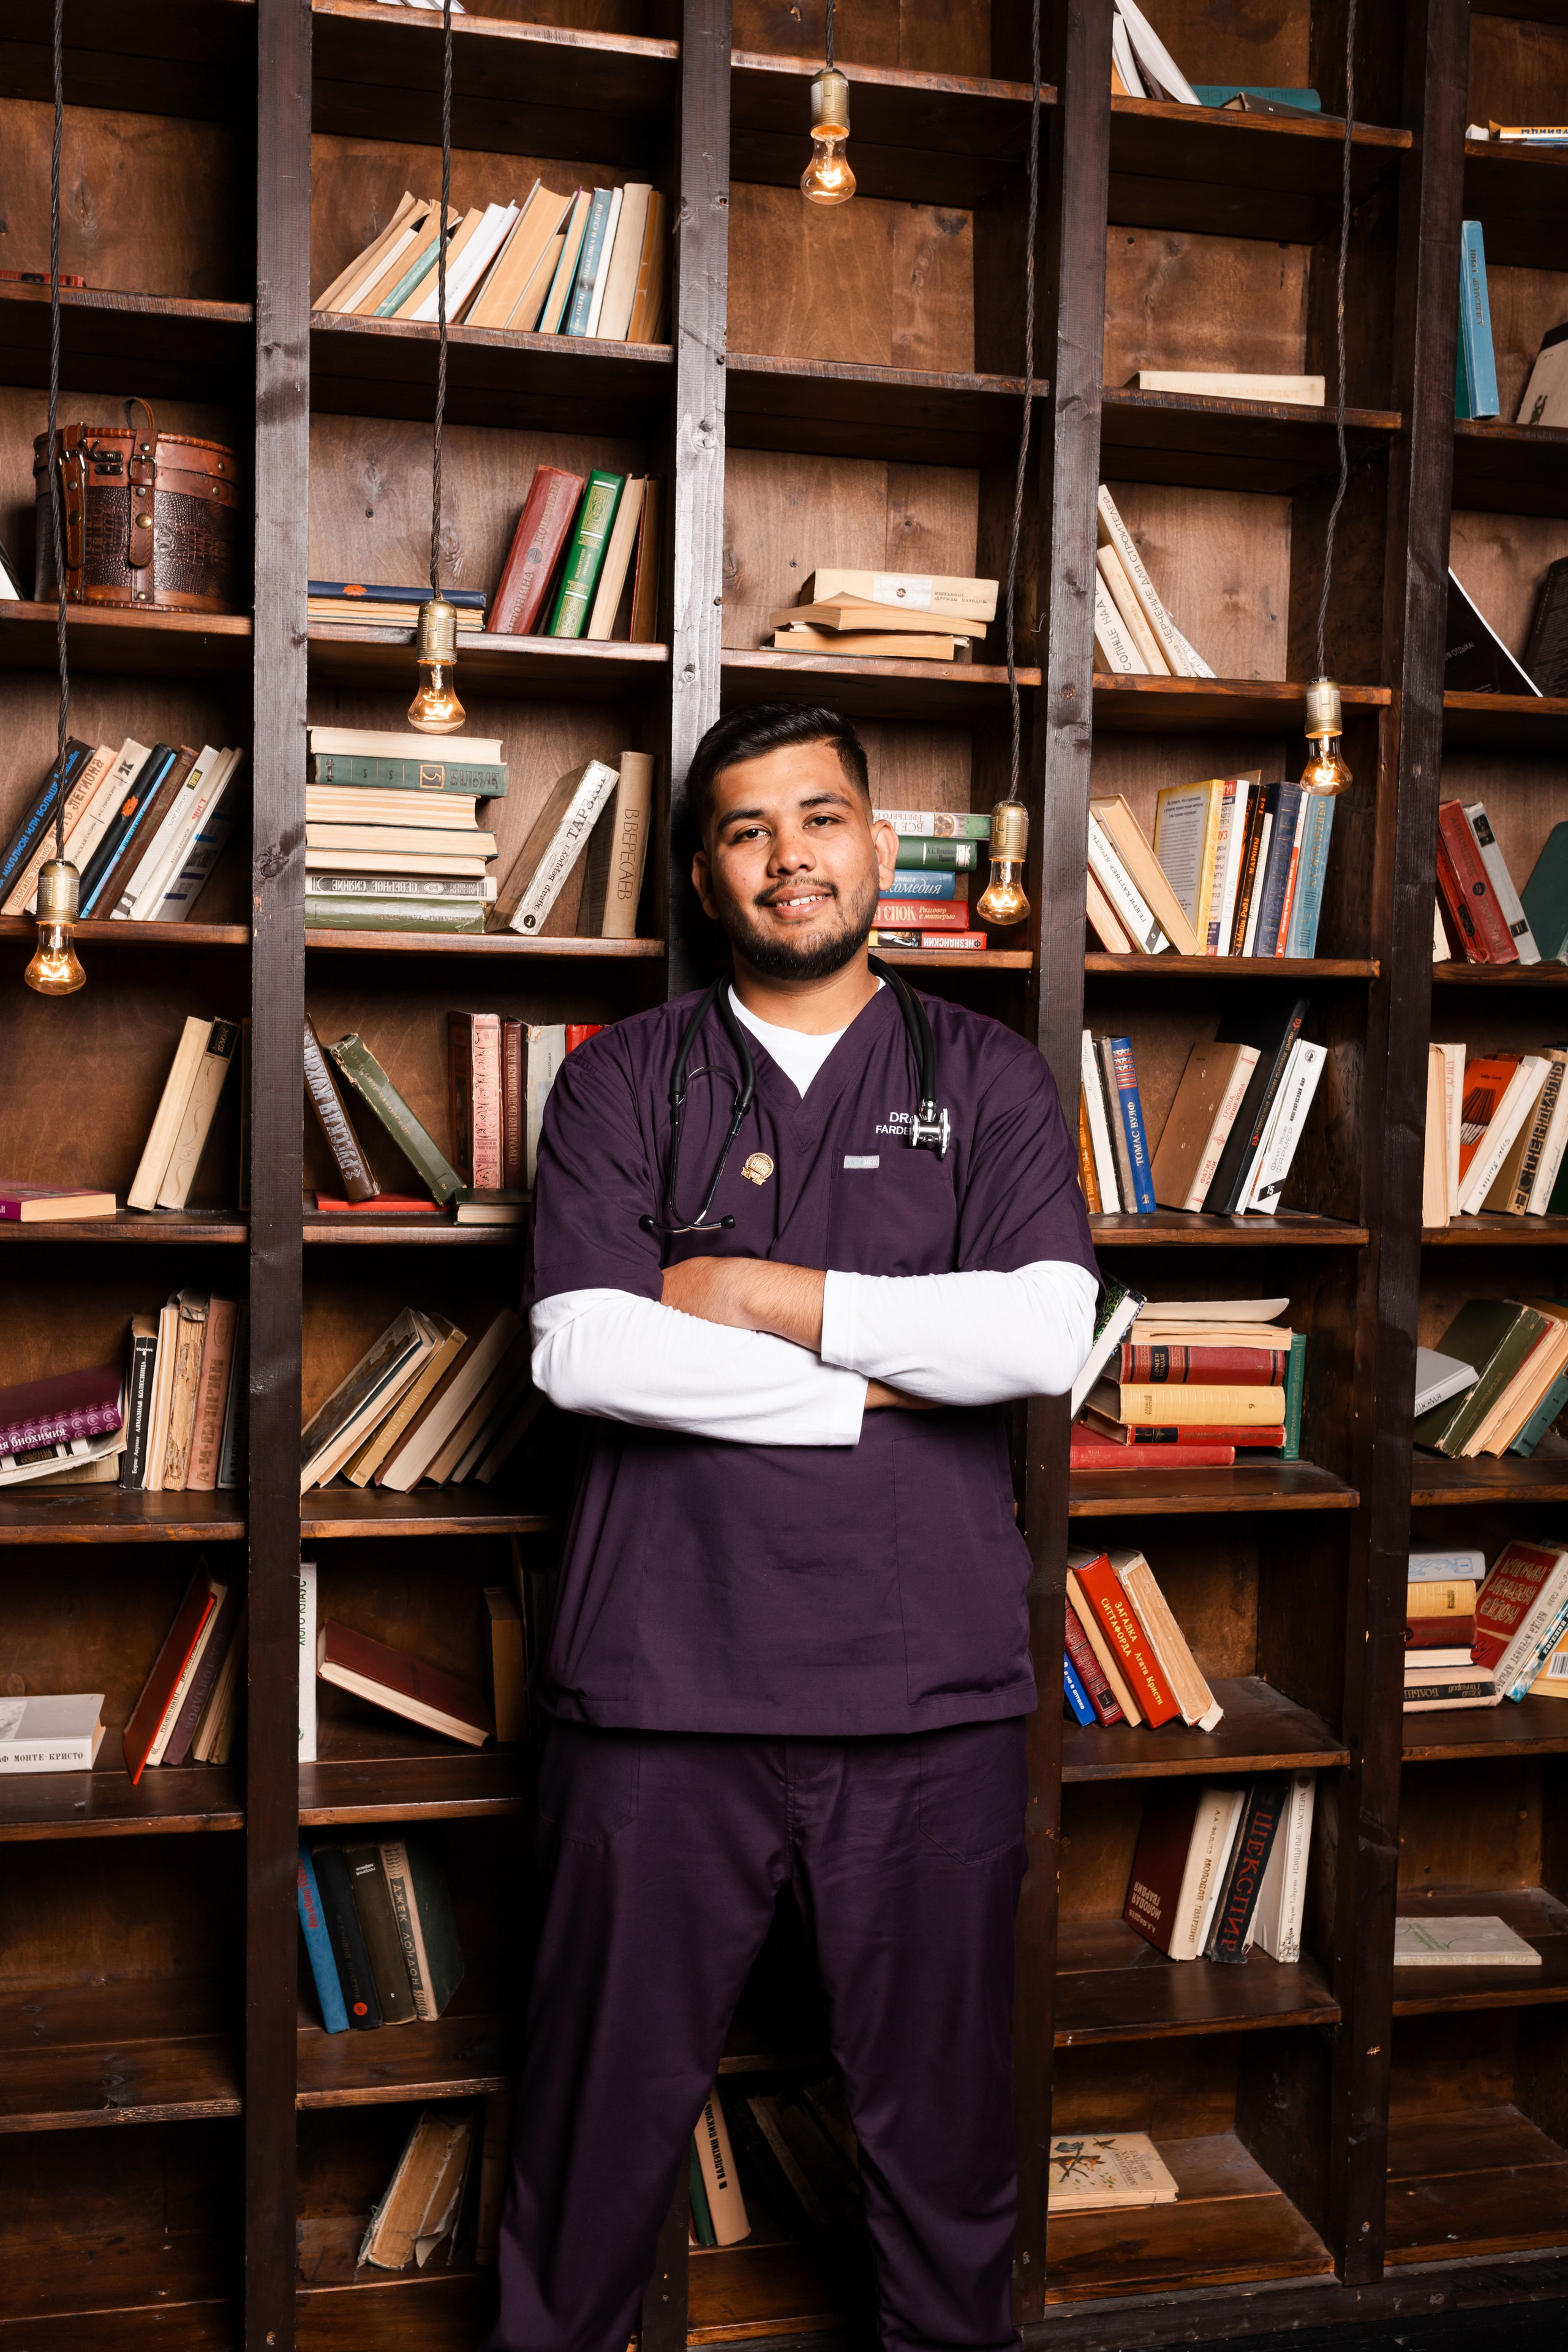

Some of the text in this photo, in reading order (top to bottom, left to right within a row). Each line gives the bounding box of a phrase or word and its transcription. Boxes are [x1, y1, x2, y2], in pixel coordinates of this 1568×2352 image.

[582, 239, 595, 279] АНЖЕЛИКА
[592, 203, 603, 230] СУЛТАН
[1474, 277, 1484, 326] АЛЕКСАНДР
[505, 477, 563, 635] АНТОНИНА КОПТЯЕВА
[572, 548, 588, 578] ВАЛЕНТИН
[1101, 495, 1176, 644] ЧЕРЧЕНИЕ ДЛЯ СТРОИТЕЛЕЙ
[1094, 598, 1133, 671] СОЛНЦЕ НАД
[66, 756, 105, 811] ЛЕГИОНА
[187, 771, 201, 787] ТАРЗАН
[449, 769, 500, 790] БАЛЬЗАК
[1, 780, 61, 877] МИЛЛИОН ИЛИ БОЛЬШЕ
[565, 774, 609, 841] ТАРЗАН
[901, 821, 923, 832] ВСЕ
[85, 821, 97, 839] ОСЕНЬ
[169, 796, 208, 863] АХИЯР ХАНИМОВ МОСТ
[1305, 800, 1328, 888] А.С.МАКАРЕНКО
[1447, 816, 1479, 877] АНТОНИНА
[11, 843, 52, 907] ШАМИЛЬ УСМАНОВ
[616, 809, 639, 900] В.ВЕРЕСАЕВ
[1247, 837, 1260, 874] МАРОНЫ
[331, 878, 417, 893] СЕВЕРНОЕ СИЯНИЕ
[883, 905, 916, 921] СПОК
[1128, 897, 1147, 923] ГЕНРИ
[1235, 919, 1246, 941] Майн
[1239, 901, 1249, 918] Рид
[213, 1027, 233, 1052] БЛОК
[1267, 1079, 1278, 1099] песни
[1284, 1031, 1296, 1051] цыган
[303, 1044, 359, 1170] РУССКАЯ КУХНЯ
[347, 1049, 411, 1137] АЛЕКСАНДР ЧАКОВСКИЙ
[507, 1034, 518, 1164] СОВРЕМЕННАЯ АВСТРАЛИЙСКАЯ НОВЕЛЛА
[1221, 1095, 1235, 1118] ТРОПА
[1227, 1082, 1246, 1120] ПЕШЕХОДА
[1287, 1087, 1303, 1121] МНОГОЯРУСНЫЙ
[1125, 1101, 1145, 1166] ТОМАС ВУЛФ
[1516, 1061, 1567, 1193] СТЕНДАЛЬ
[1275, 1126, 1294, 1173] ФАРМЕР
[1085, 1173, 1094, 1195] Майн
[1199, 1159, 1212, 1183] ФАТИХ
[1204, 1161, 1217, 1185] ХУСНИ
[1267, 1185, 1274, 1195] 15
[1141, 1194, 1150, 1205] 2
[137, 1360, 147, 1398] КОЛЕСНИЦА
[1286, 1348, 1303, 1448] ОРФОГРАФИЧЕСКИЙ СЛОВАРЬ
[134, 1400, 143, 1432] АЛМАЗНАЯ
[377, 1384, 425, 1447] ГАЛИНА ВОСТОКОВА
[10, 1428, 66, 1449] биохимия
[1097, 1597, 1135, 1657] СИТТАФОРДА
[1112, 1600, 1140, 1643] ЗАГАДКА
[1542, 1619, 1567, 1654] ЕВГЕНИЙ
[183, 1663, 216, 1730] ГОНЧАРОВ
[1072, 1688, 1085, 1710] аптеке
[1133, 1651, 1165, 1706] Агата Кристи
[1403, 1687, 1438, 1698] БОЛЬШ
[158, 1691, 179, 1733] ГИМНАЗИСТЫ
[14, 1752, 83, 1762] МОНТЕ-КРИСТО
[1295, 1792, 1307, 1829] МАСТЕРА
[1291, 1832, 1303, 1874] ИЗЯЩНЫЕ
[1134, 1880, 1160, 1906] ГВАРДИЯ
[1187, 1858, 1212, 1943] МОЛОДАЯ ГВАРДИЯ
[1219, 1810, 1276, 1953] ШЕКСПИР
[1131, 1892, 1161, 1920] МОЛОДАЯ
[392, 1883, 421, 1986] ДЖЕК ЛОНДОН
[703, 2103, 725, 2179] ВАЛЕНТИН ПИКУЛЬ
